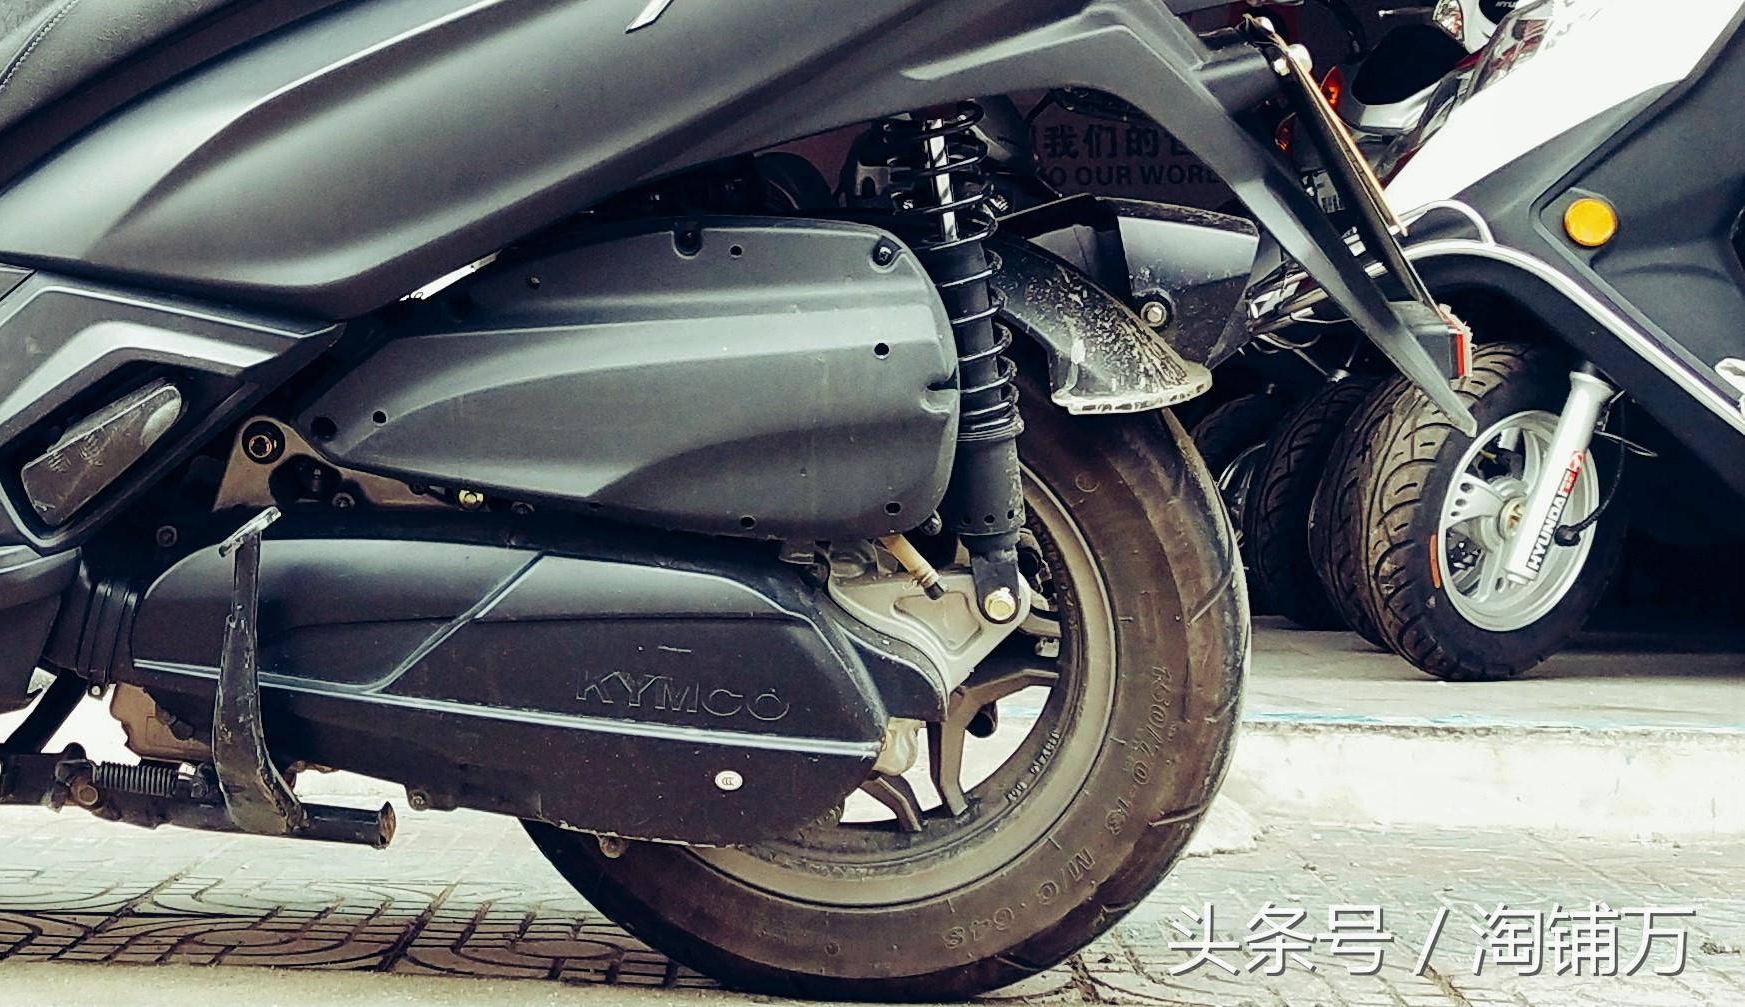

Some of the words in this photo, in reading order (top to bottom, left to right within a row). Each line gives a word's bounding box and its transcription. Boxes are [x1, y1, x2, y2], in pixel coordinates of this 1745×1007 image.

[1031, 123, 1189, 159] 我们的
[1075, 165, 1132, 186] OUR
[1140, 164, 1220, 185] WORL
[1526, 490, 1568, 571] HYUNDAI
[575, 670, 791, 721] KYMCO
